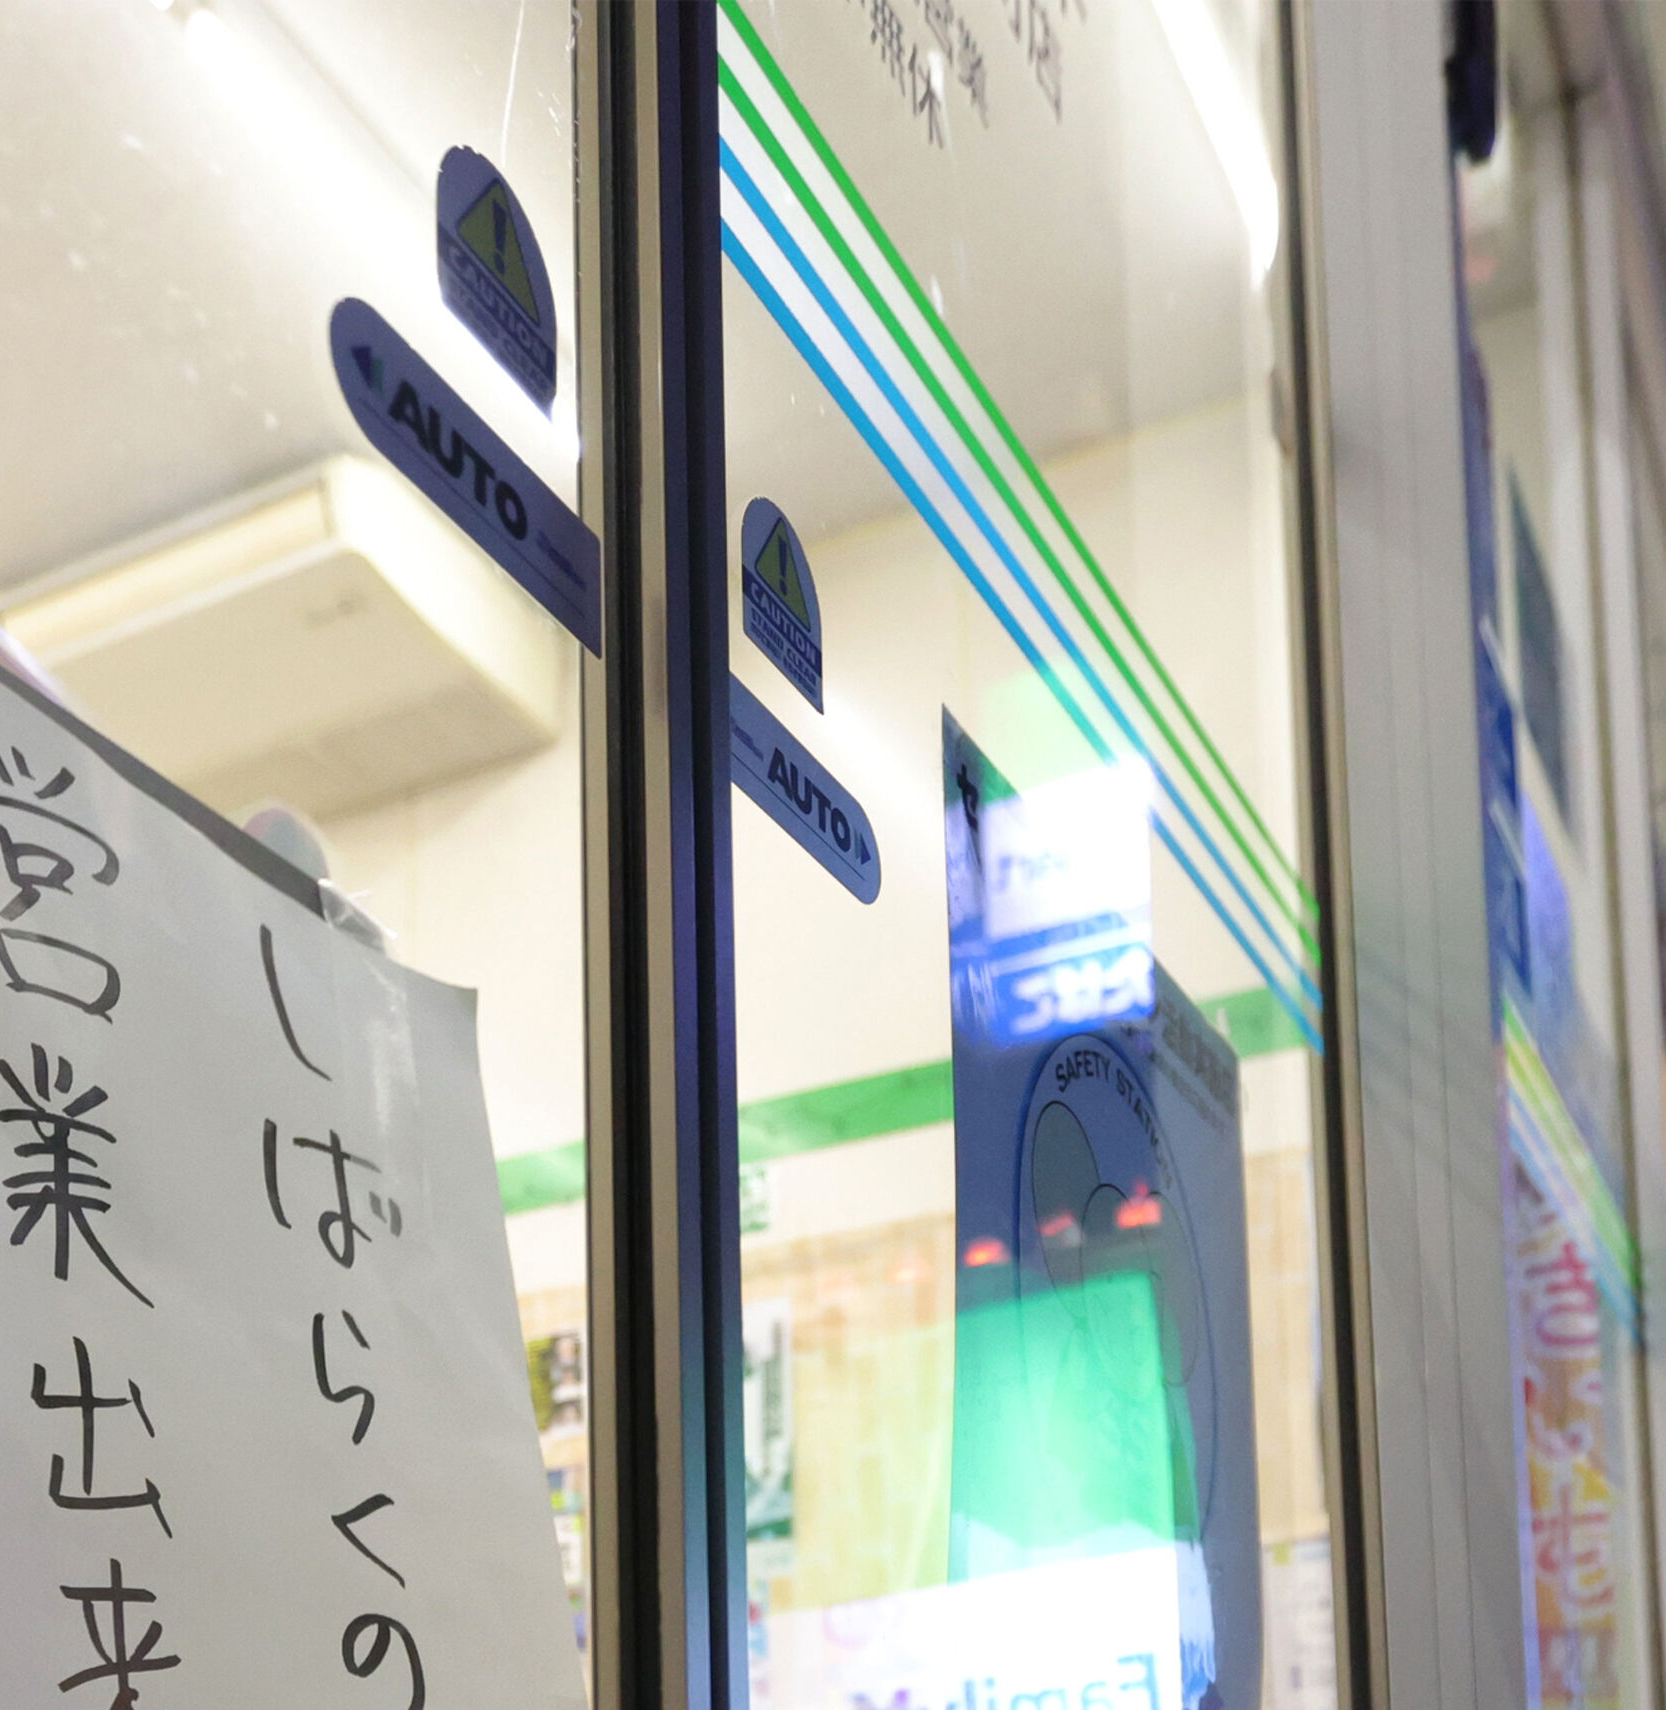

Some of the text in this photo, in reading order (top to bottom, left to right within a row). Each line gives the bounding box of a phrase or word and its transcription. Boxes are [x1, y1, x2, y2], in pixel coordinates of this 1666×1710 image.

[388, 380, 528, 540] AUTO
[750, 582, 817, 666] CAUTION
[767, 747, 851, 853] AUTO
[1055, 1050, 1110, 1093] SAFETY
